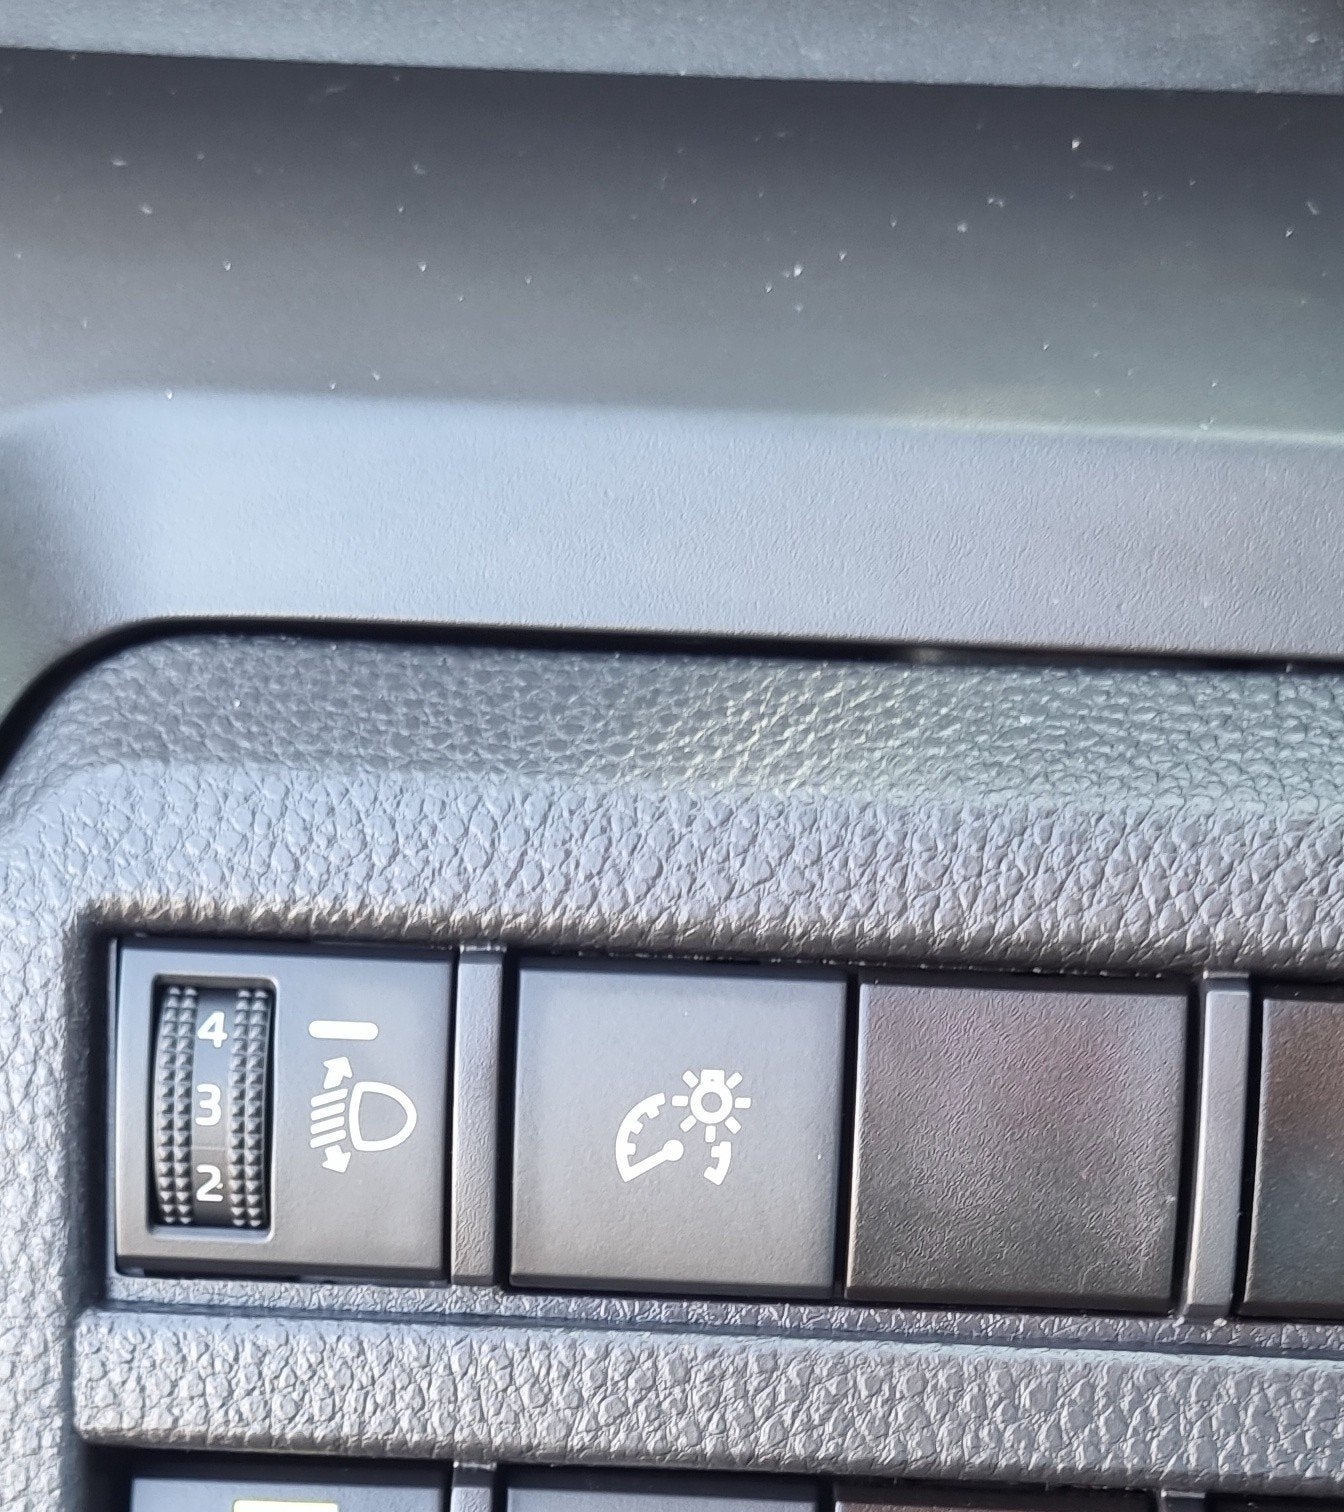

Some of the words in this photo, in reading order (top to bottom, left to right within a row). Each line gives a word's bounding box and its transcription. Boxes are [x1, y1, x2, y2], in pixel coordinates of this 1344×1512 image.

[197, 1011, 227, 1048] 4
[195, 1084, 222, 1126] 3
[195, 1164, 224, 1202] 2
